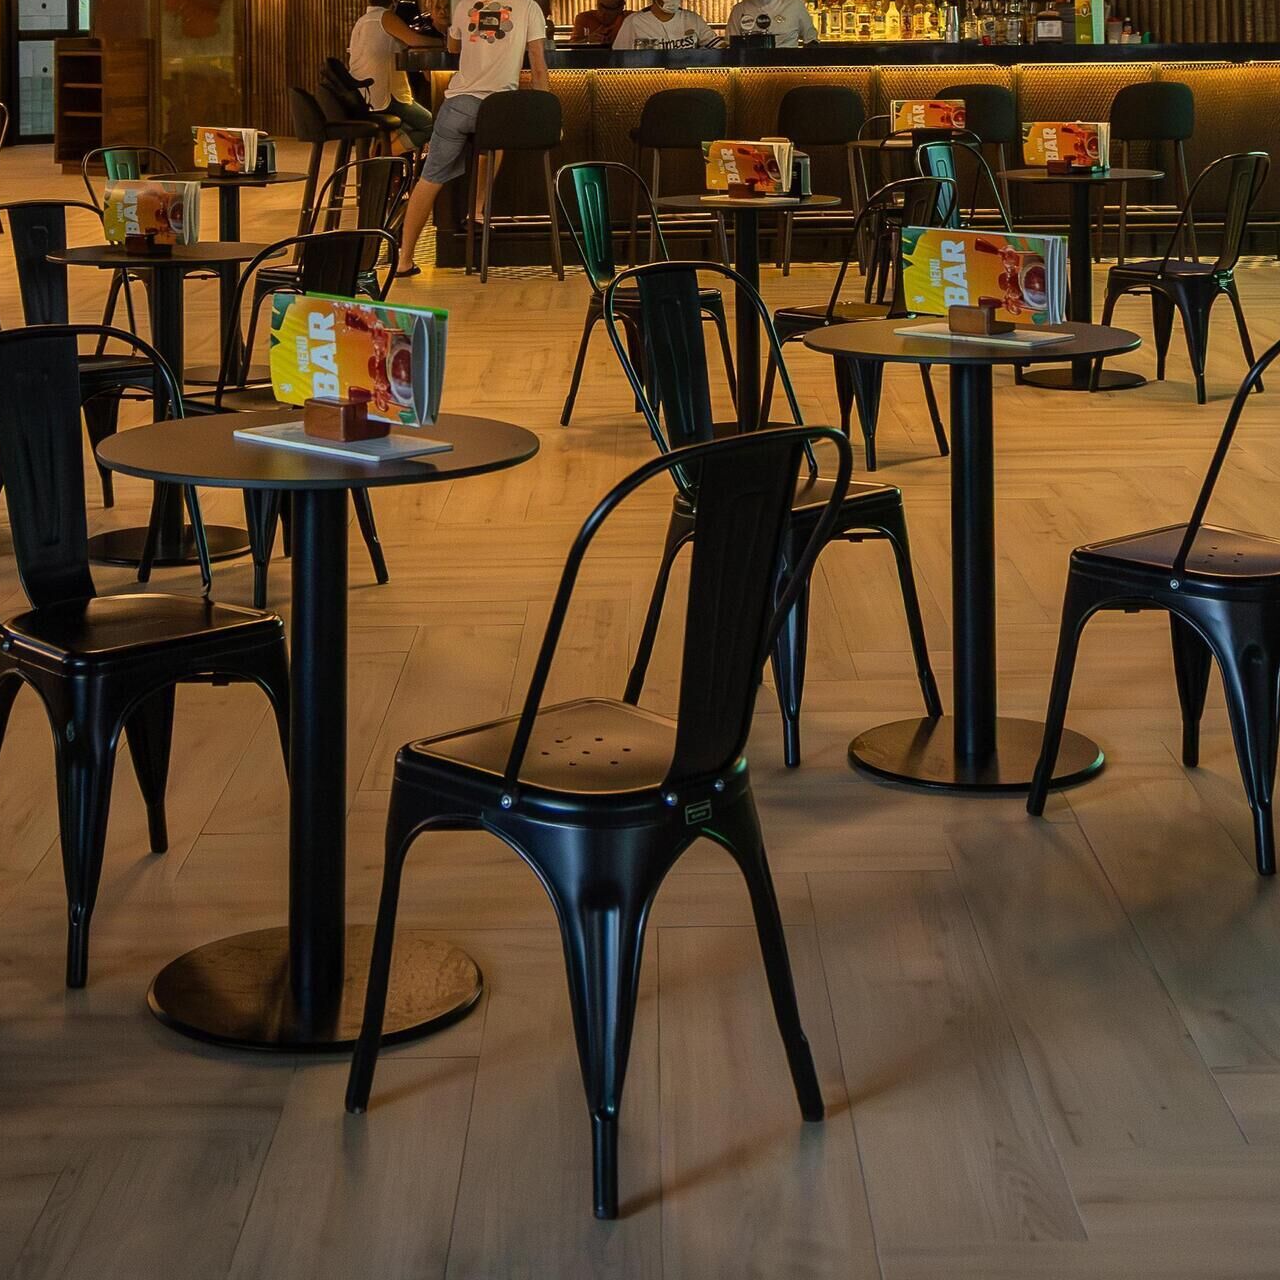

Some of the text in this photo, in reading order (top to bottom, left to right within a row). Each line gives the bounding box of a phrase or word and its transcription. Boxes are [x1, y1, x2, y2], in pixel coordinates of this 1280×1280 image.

[205, 131, 219, 163] BAR
[1042, 127, 1059, 160] BAR
[720, 148, 741, 183] BAR
[124, 189, 140, 235] BAR
[940, 239, 969, 307] BAR
[295, 335, 310, 373] MENU
[308, 311, 340, 400] BAR
